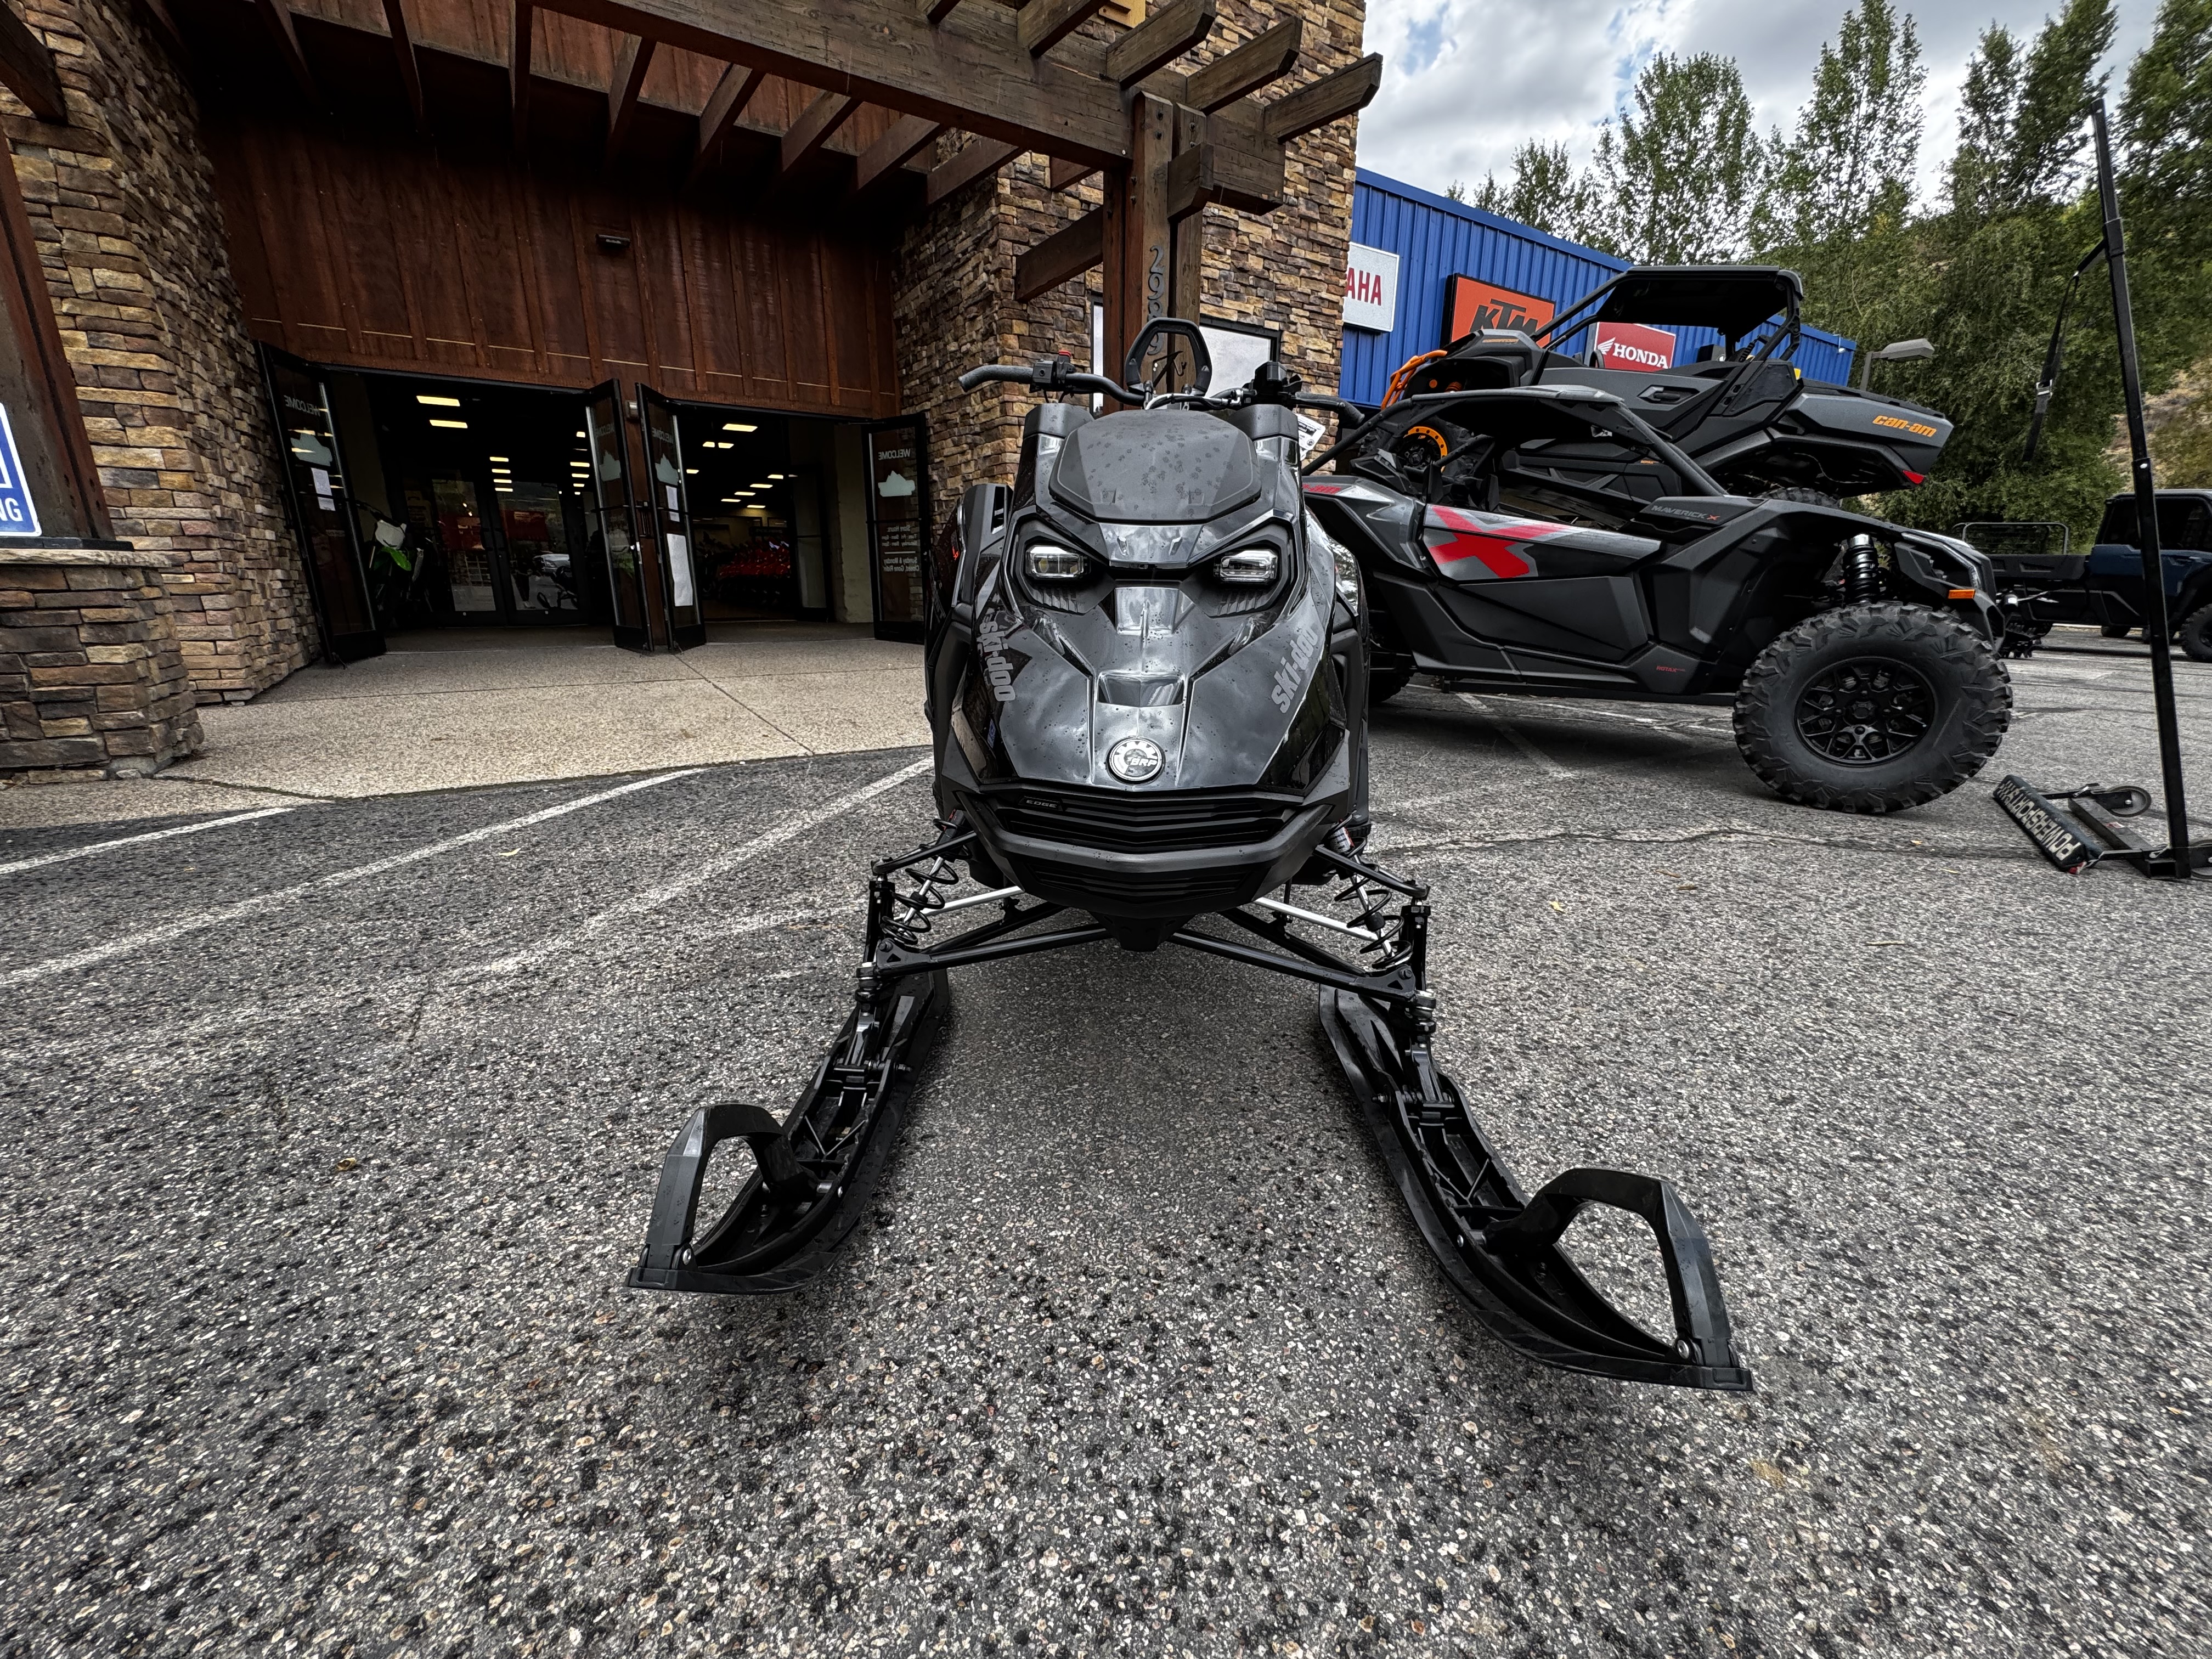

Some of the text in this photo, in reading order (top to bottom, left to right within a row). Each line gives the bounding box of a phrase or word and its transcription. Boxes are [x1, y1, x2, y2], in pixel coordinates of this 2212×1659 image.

[1469, 298, 1538, 338] KTM
[1612, 342, 1668, 369] HONDA
[1872, 415, 1937, 437] can-am
[1651, 505, 1708, 519] MAVERICK
[979, 621, 1015, 702] ski-doo
[1271, 628, 1318, 713] ski-doo
[1130, 758, 1158, 767] BRP
[1026, 800, 1057, 808] EDGE
